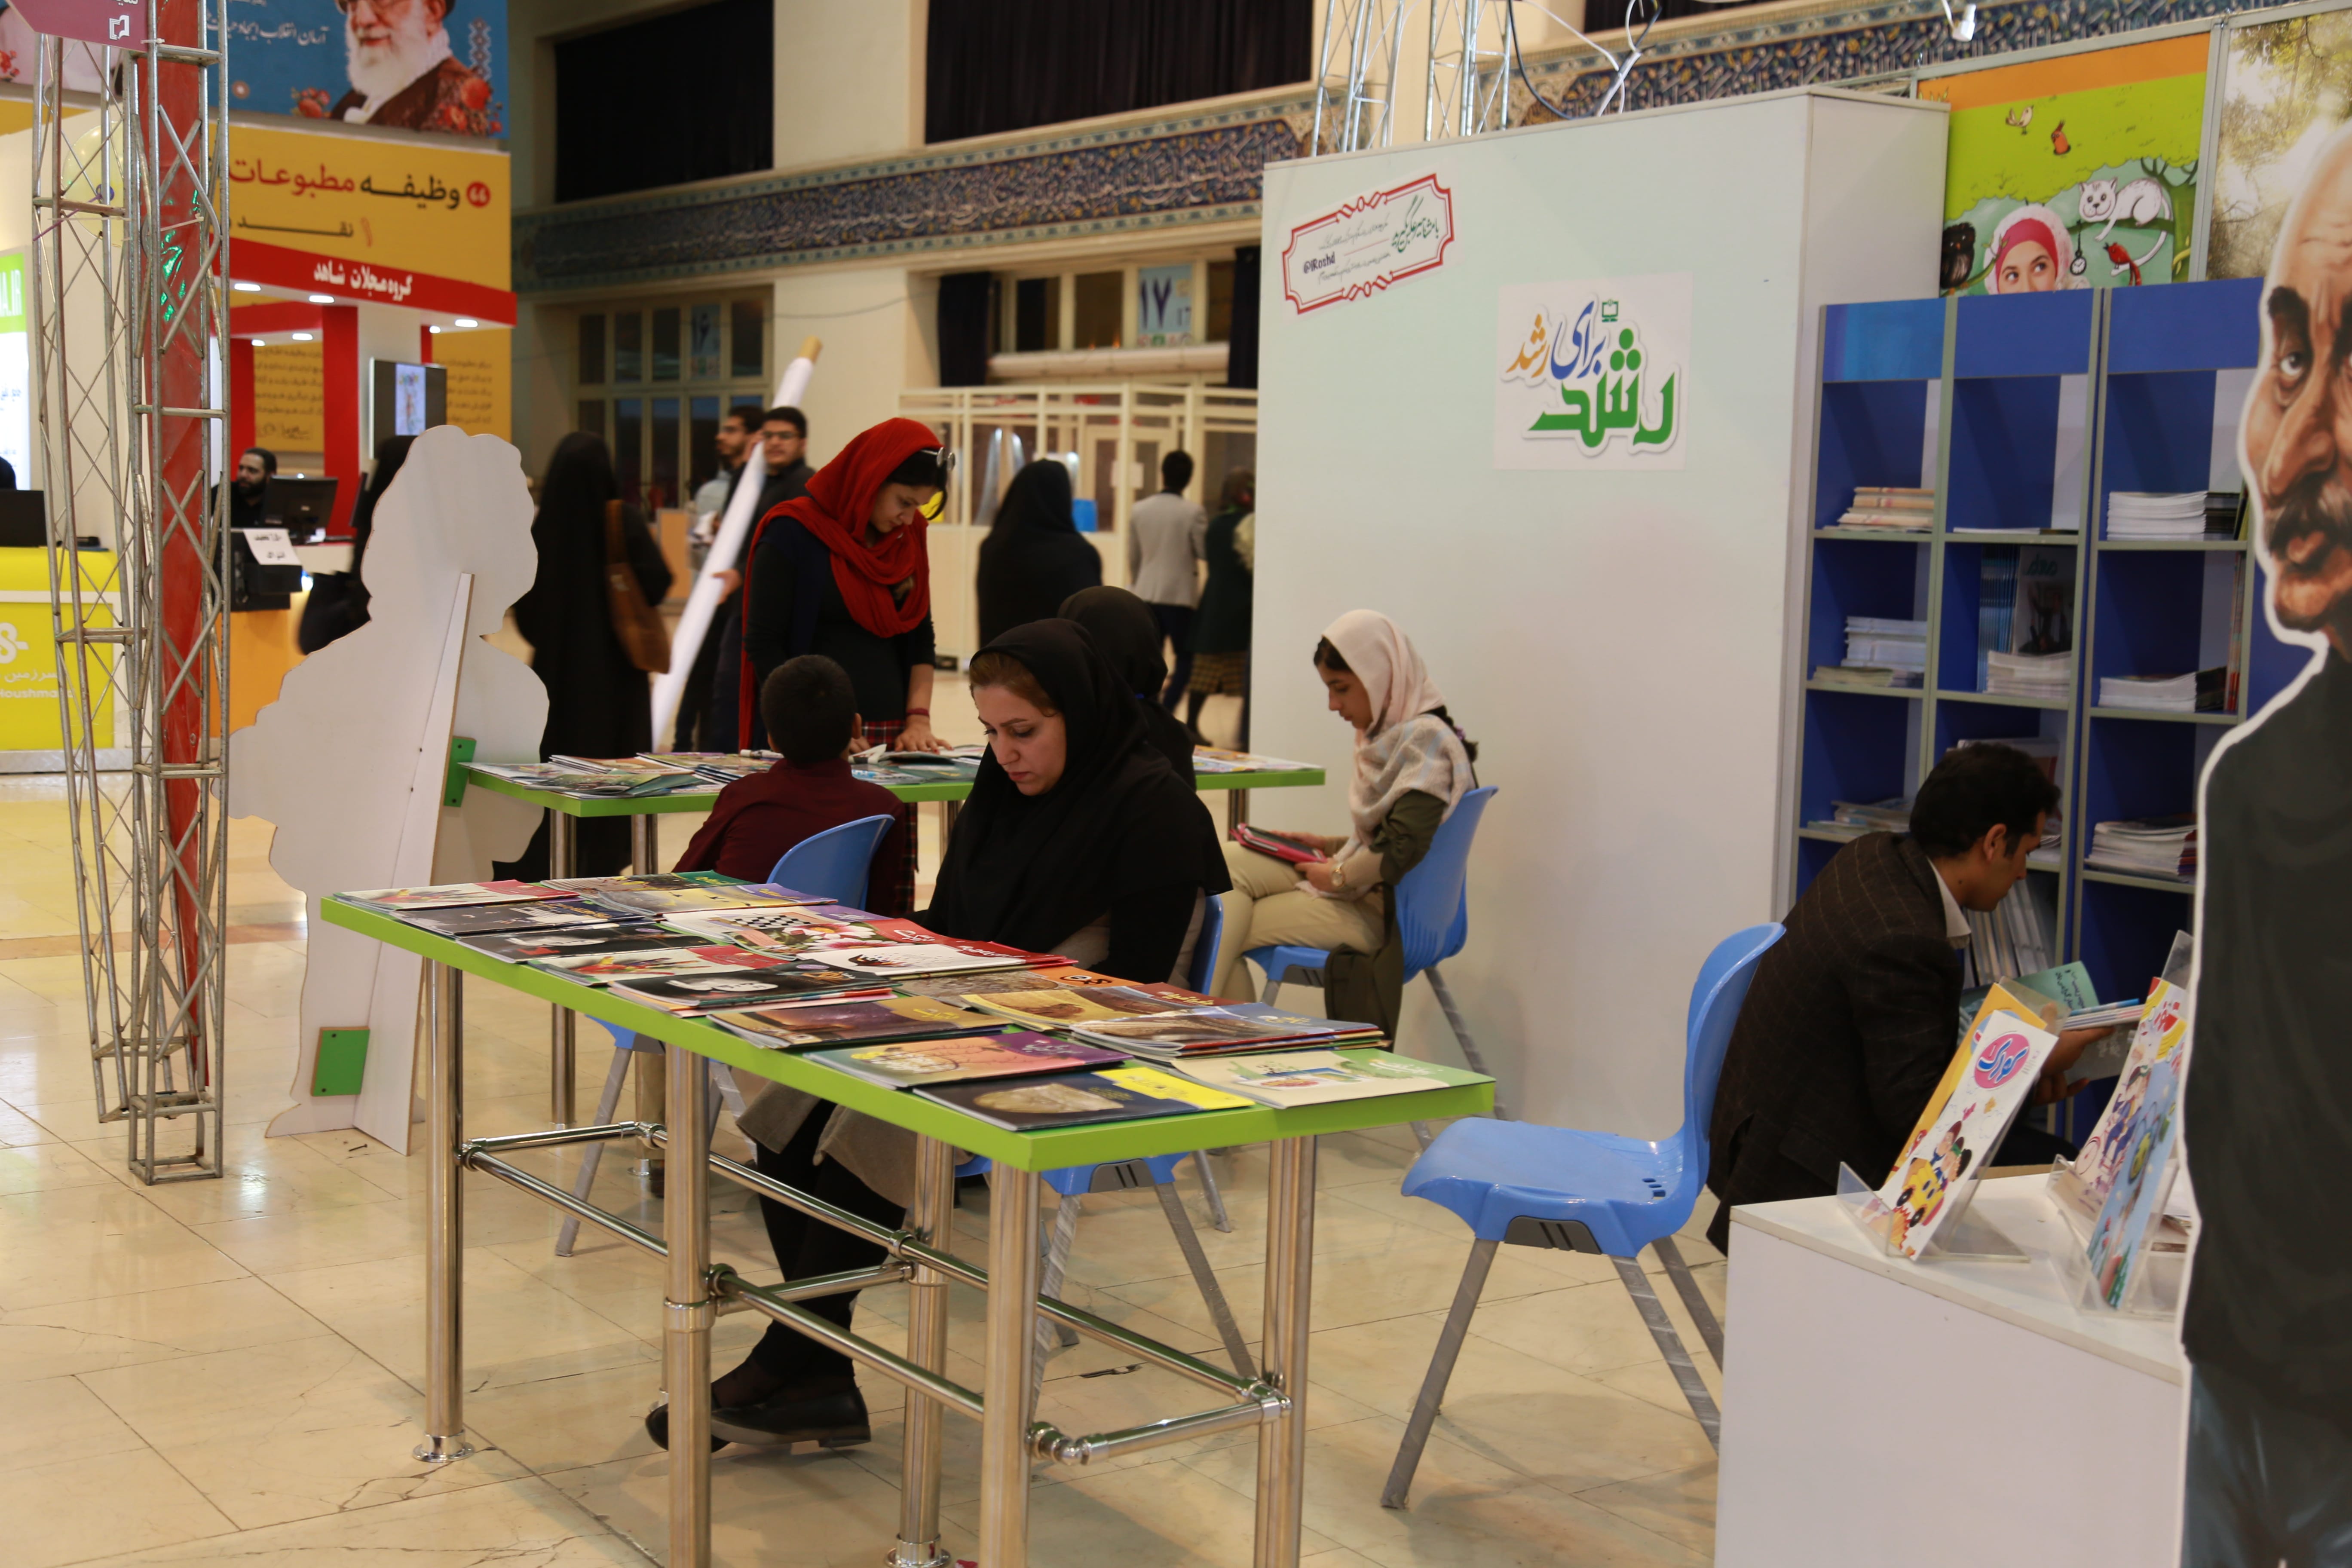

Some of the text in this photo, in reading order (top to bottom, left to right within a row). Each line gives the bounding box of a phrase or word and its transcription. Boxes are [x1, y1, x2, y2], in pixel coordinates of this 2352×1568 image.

[229, 159, 356, 200] مطبوعات
[360, 174, 460, 209] وظیفه
[237, 217, 354, 238] نقد
[313, 258, 413, 302] گروه مجلات شاهد
[1506, 300, 1606, 380] برای رشد
[1527, 328, 1675, 448] رشد
